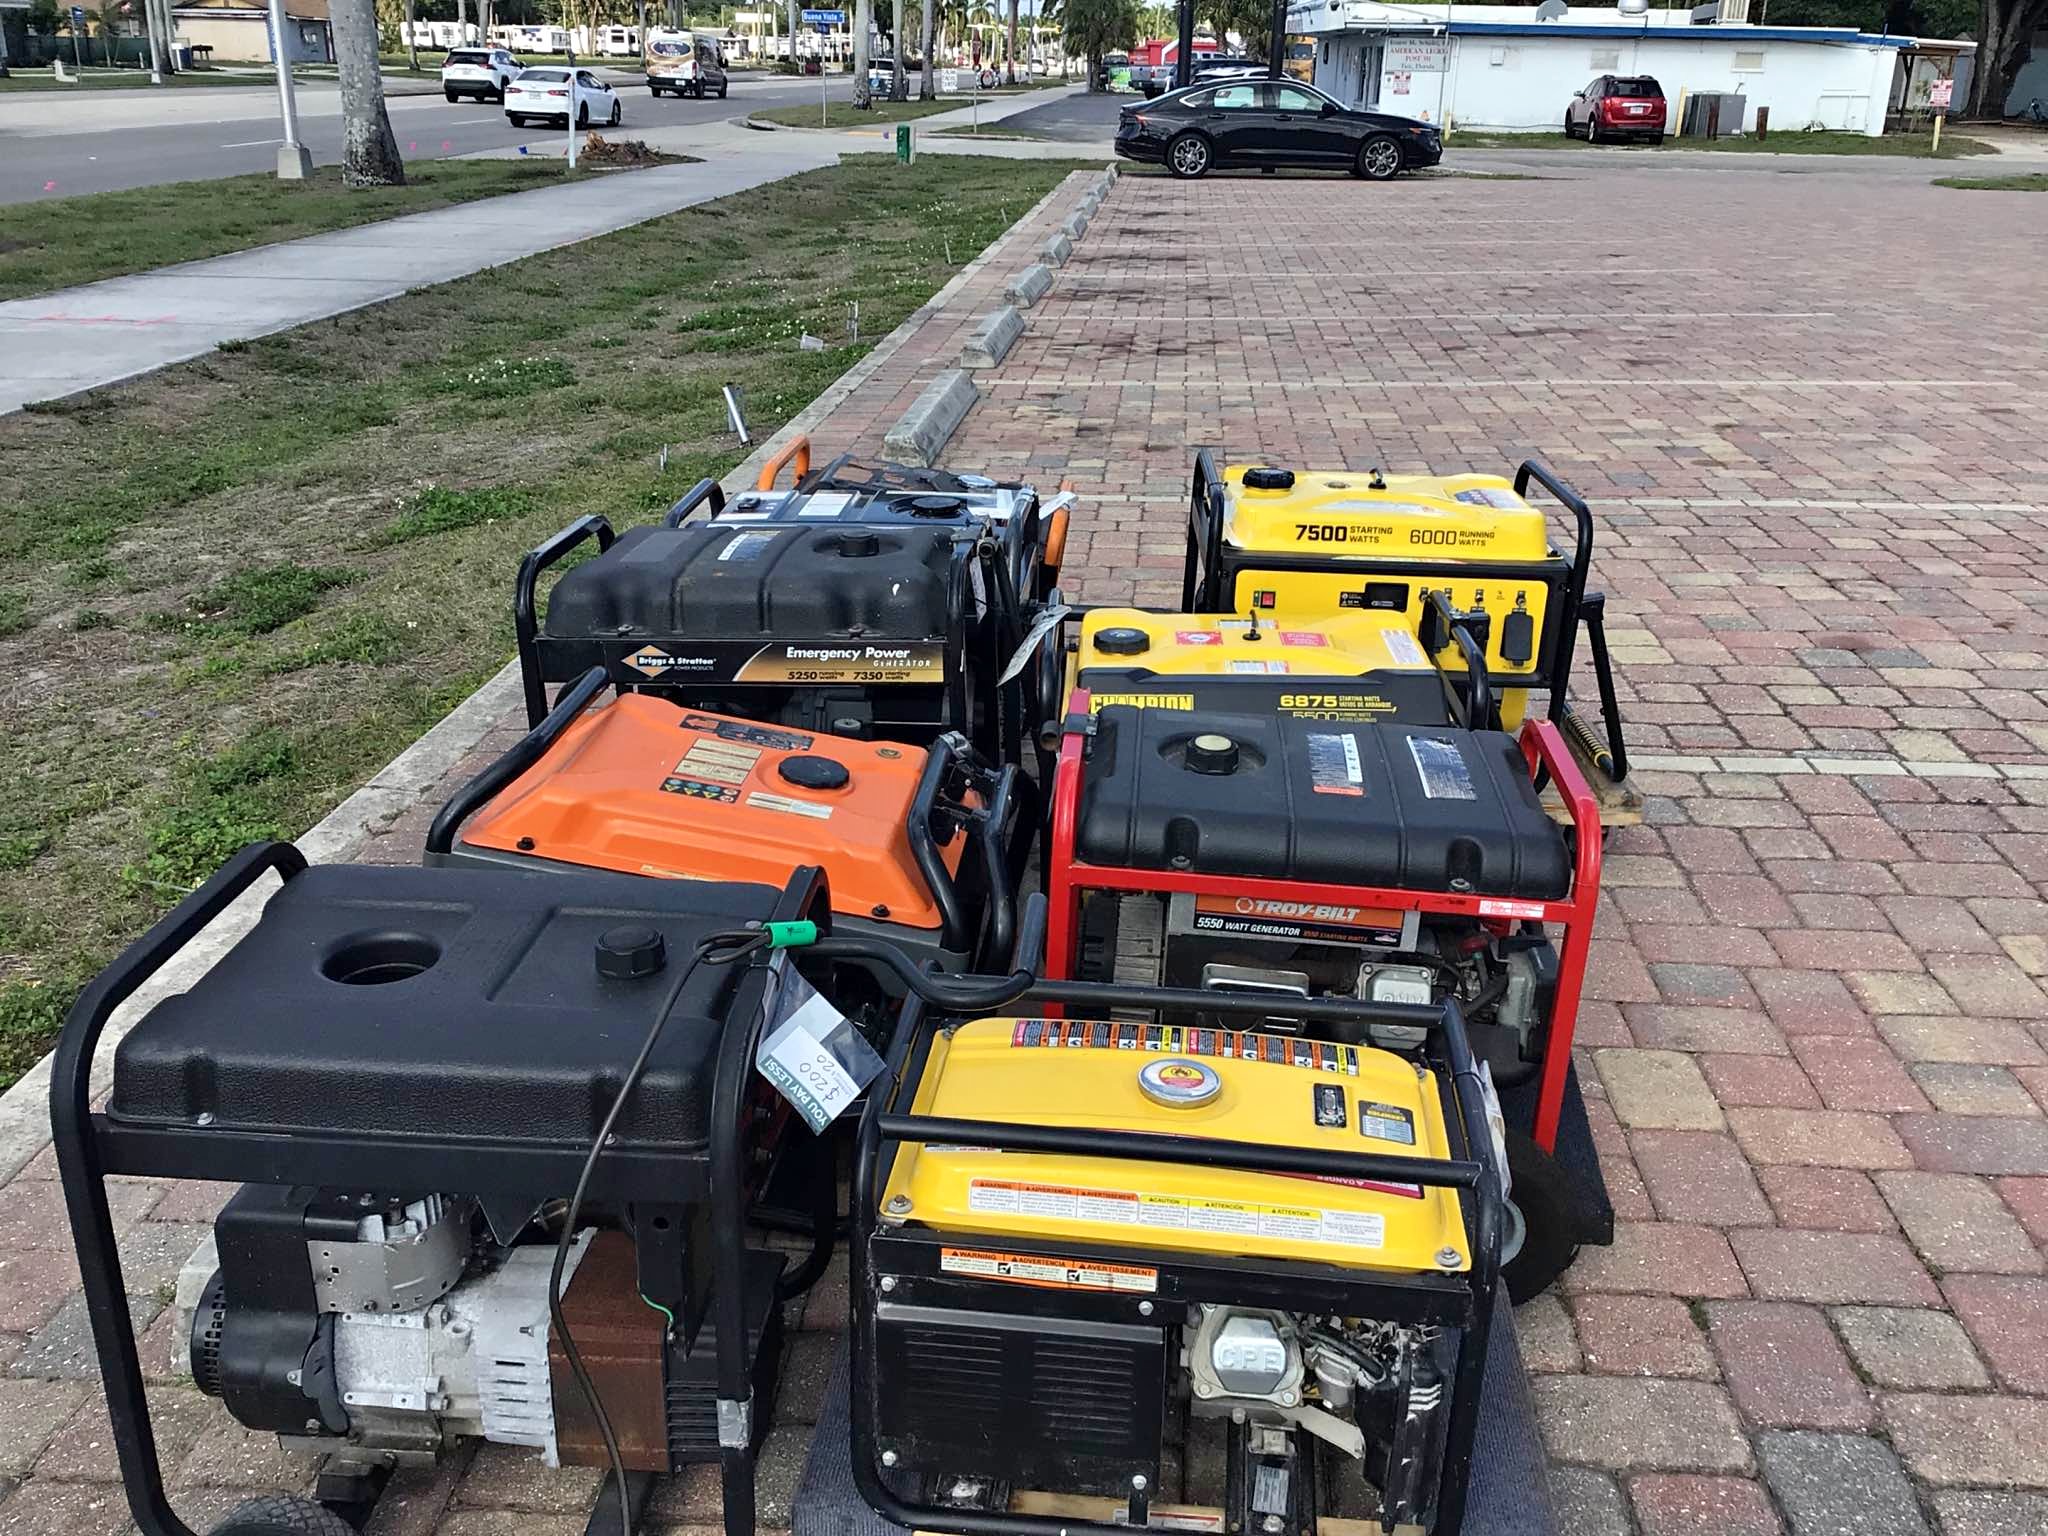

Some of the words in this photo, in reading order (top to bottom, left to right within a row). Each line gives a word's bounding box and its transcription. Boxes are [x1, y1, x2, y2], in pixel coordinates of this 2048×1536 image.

[1295, 524, 1348, 542] 7500
[1350, 525, 1393, 535] STARTING
[1350, 535, 1380, 544] WATTS
[1410, 529, 1457, 545] 6000
[1459, 530, 1495, 539] RUNNING
[1459, 538, 1486, 547] WATTS
[786, 647, 861, 661] Emergency
[865, 646, 910, 658] Power
[638, 656, 667, 666] Briggs
[668, 657, 675, 665] &
[677, 657, 714, 665] Stratton
[787, 671, 818, 680] 5250
[853, 671, 884, 680] 7350
[1280, 695, 1338, 707] 6875
[1256, 900, 1360, 921] TROY-BILT
[1197, 917, 1224, 928] 5550
[1225, 922, 1250, 931] WATT
[1250, 924, 1301, 936] GENERATOR
[764, 1059, 793, 1086] LESS!
[799, 1062, 840, 1102] $200
[789, 1084, 811, 1105] PAY
[807, 1102, 829, 1126] YOU
[959, 1251, 997, 1260] WARNING
[1018, 1256, 1066, 1267] ADVERTENCIA
[1087, 1264, 1152, 1276] AVERTISSEMENT
